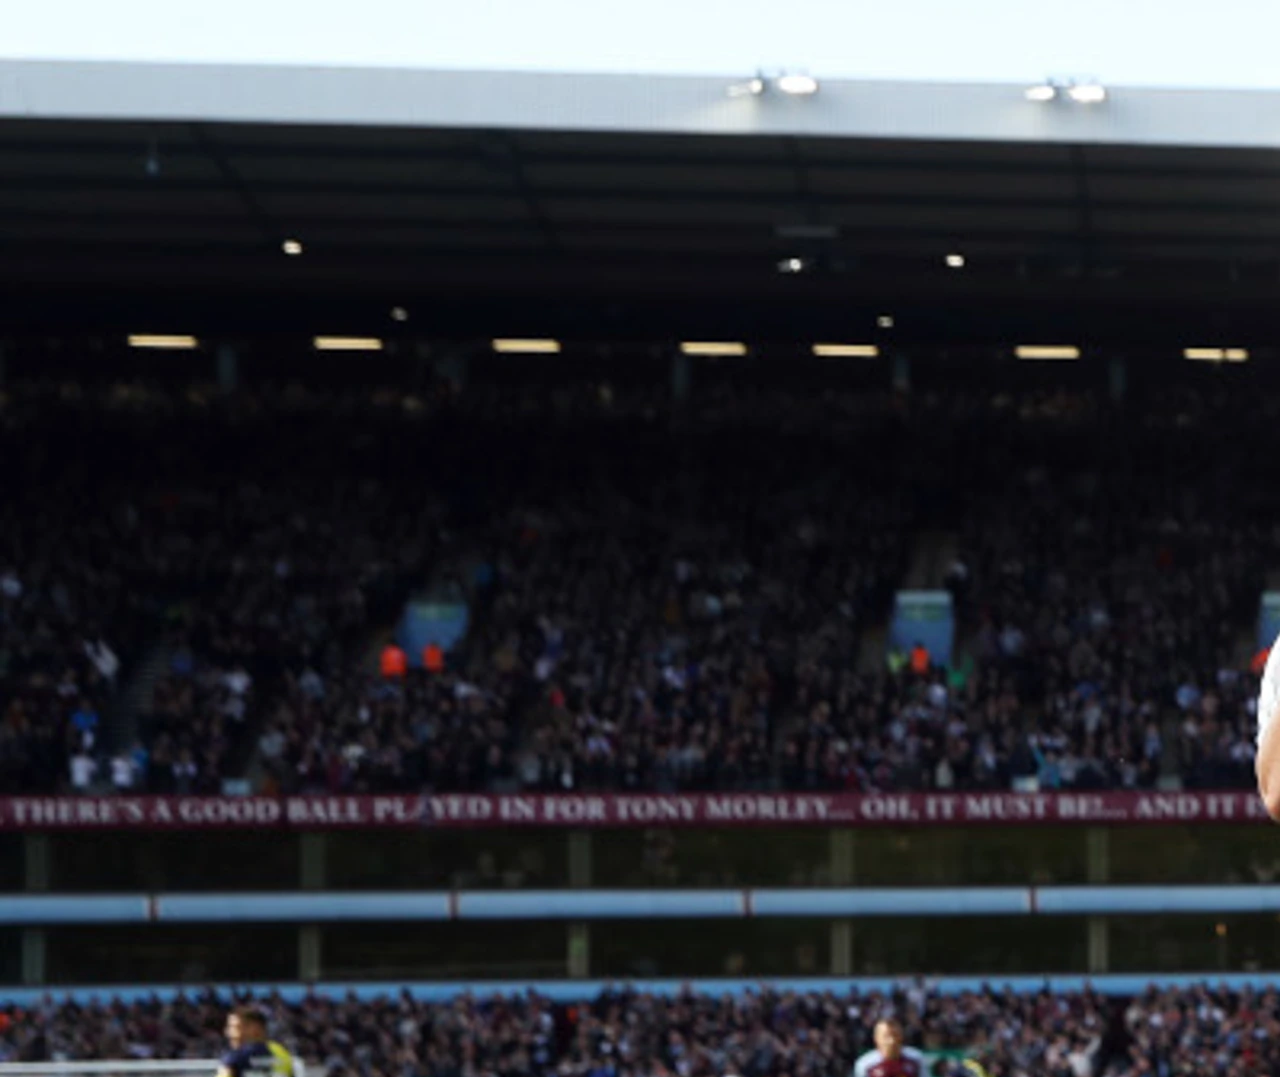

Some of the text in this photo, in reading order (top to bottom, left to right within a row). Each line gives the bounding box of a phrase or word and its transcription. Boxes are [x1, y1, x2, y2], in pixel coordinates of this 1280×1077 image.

[11, 797, 145, 822] THERE'S
[152, 797, 170, 822] A
[177, 797, 282, 822] GOOD
[286, 797, 362, 822] BALL
[373, 796, 492, 821] PLAYED
[499, 796, 536, 820] IN
[542, 796, 606, 820] FOR
[614, 796, 698, 820] TONY
[925, 795, 956, 819] IT
[965, 794, 1048, 818] MUST
[1134, 793, 1200, 817] AND
[1206, 793, 1238, 817] IT
